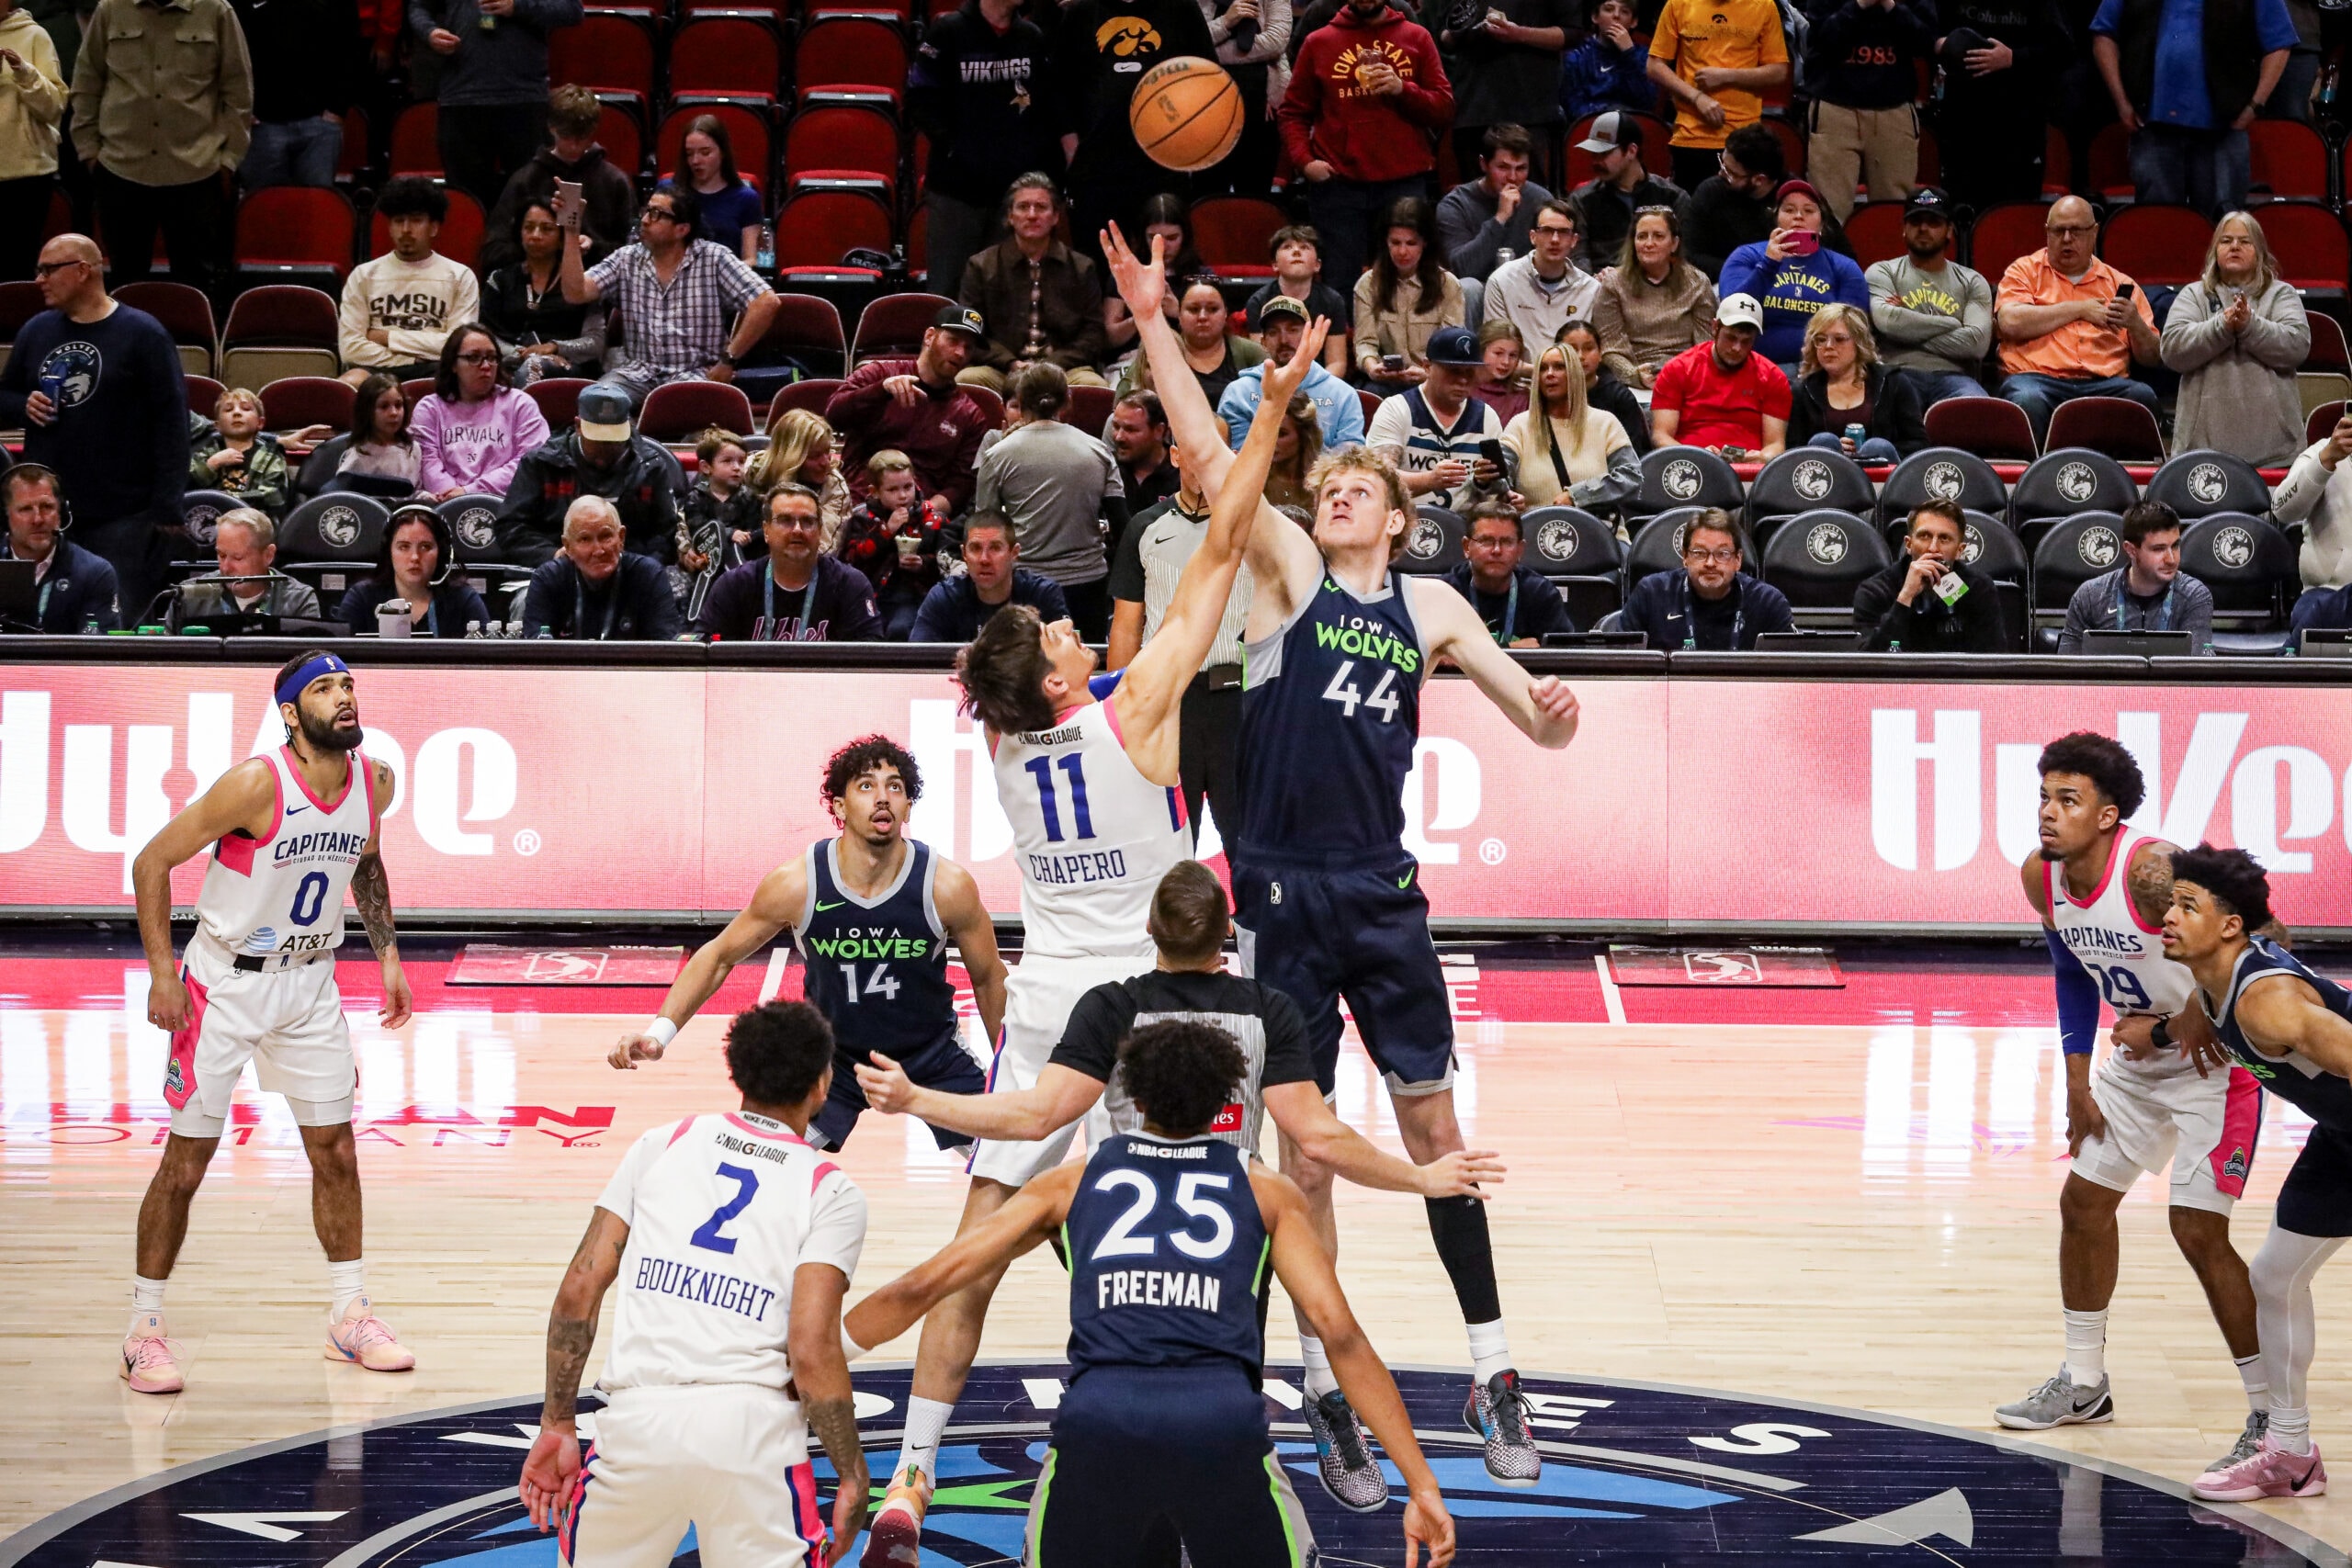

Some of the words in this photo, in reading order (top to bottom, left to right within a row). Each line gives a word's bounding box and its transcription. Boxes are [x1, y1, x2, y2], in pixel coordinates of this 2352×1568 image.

[960, 57, 1032, 83] VIKINGS
[1373, 39, 1413, 78] STATE
[1773, 272, 1831, 296] CAPITANES
[369, 293, 447, 319] SMSU
[1763, 295, 1826, 315] BALONCEST
[1902, 287, 1961, 316] CAPITANES
[55, 344, 96, 355] WOLVES
[442, 425, 506, 448] ORWALK
[1315, 620, 1419, 673] WOLVES
[1321, 660, 1400, 723] 44
[1024, 752, 1098, 842] 11
[275, 831, 367, 861] CAPITANES
[292, 854, 315, 864] CIUDAD
[1029, 849, 1126, 884] CHAPERO
[289, 871, 330, 927] 0
[279, 931, 334, 952] AT&T
[835, 927, 902, 939] IOWA
[2059, 927, 2143, 953] APITANES
[809, 937, 929, 959] WOLVES
[840, 963, 901, 1003] 14
[743, 1112, 761, 1124] NIKE
[761, 1118, 779, 1130] PRO
[690, 1161, 760, 1255] 2
[1091, 1168, 1235, 1261] 25
[636, 1257, 775, 1323] BOUKNIGHT
[1098, 1269, 1221, 1314] FREEMAN
